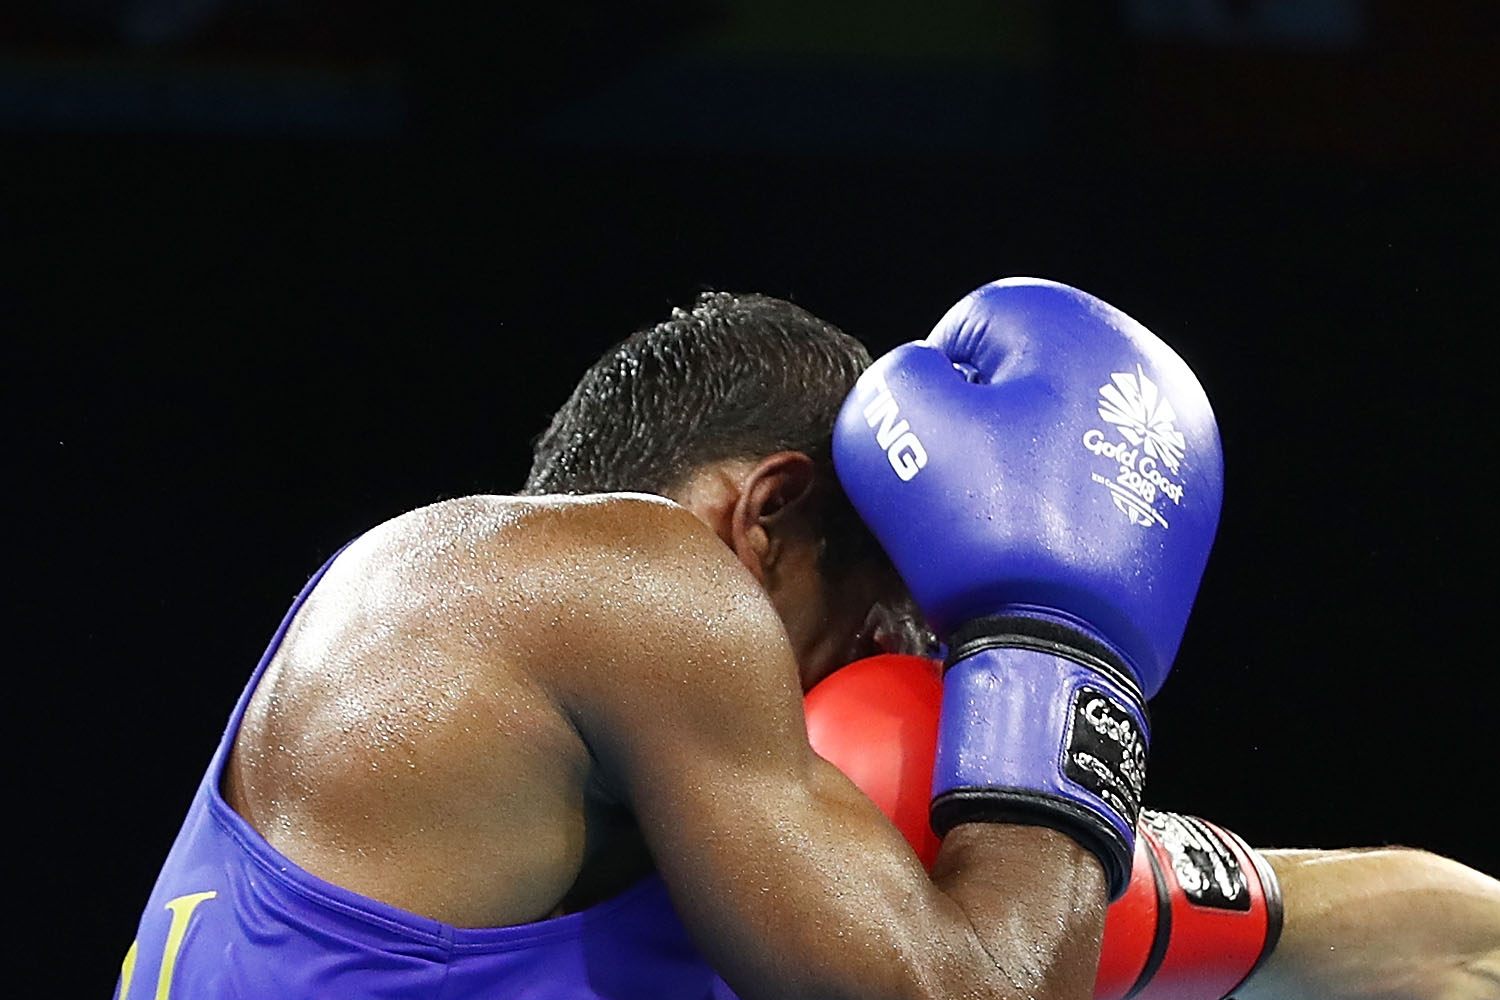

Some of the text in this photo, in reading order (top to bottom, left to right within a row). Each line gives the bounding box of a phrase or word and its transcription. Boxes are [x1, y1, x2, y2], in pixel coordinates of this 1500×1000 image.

[856, 367, 928, 482] TING
[1083, 429, 1139, 470] Gold
[1139, 456, 1184, 506] Coast
[1116, 465, 1156, 504] 2018
